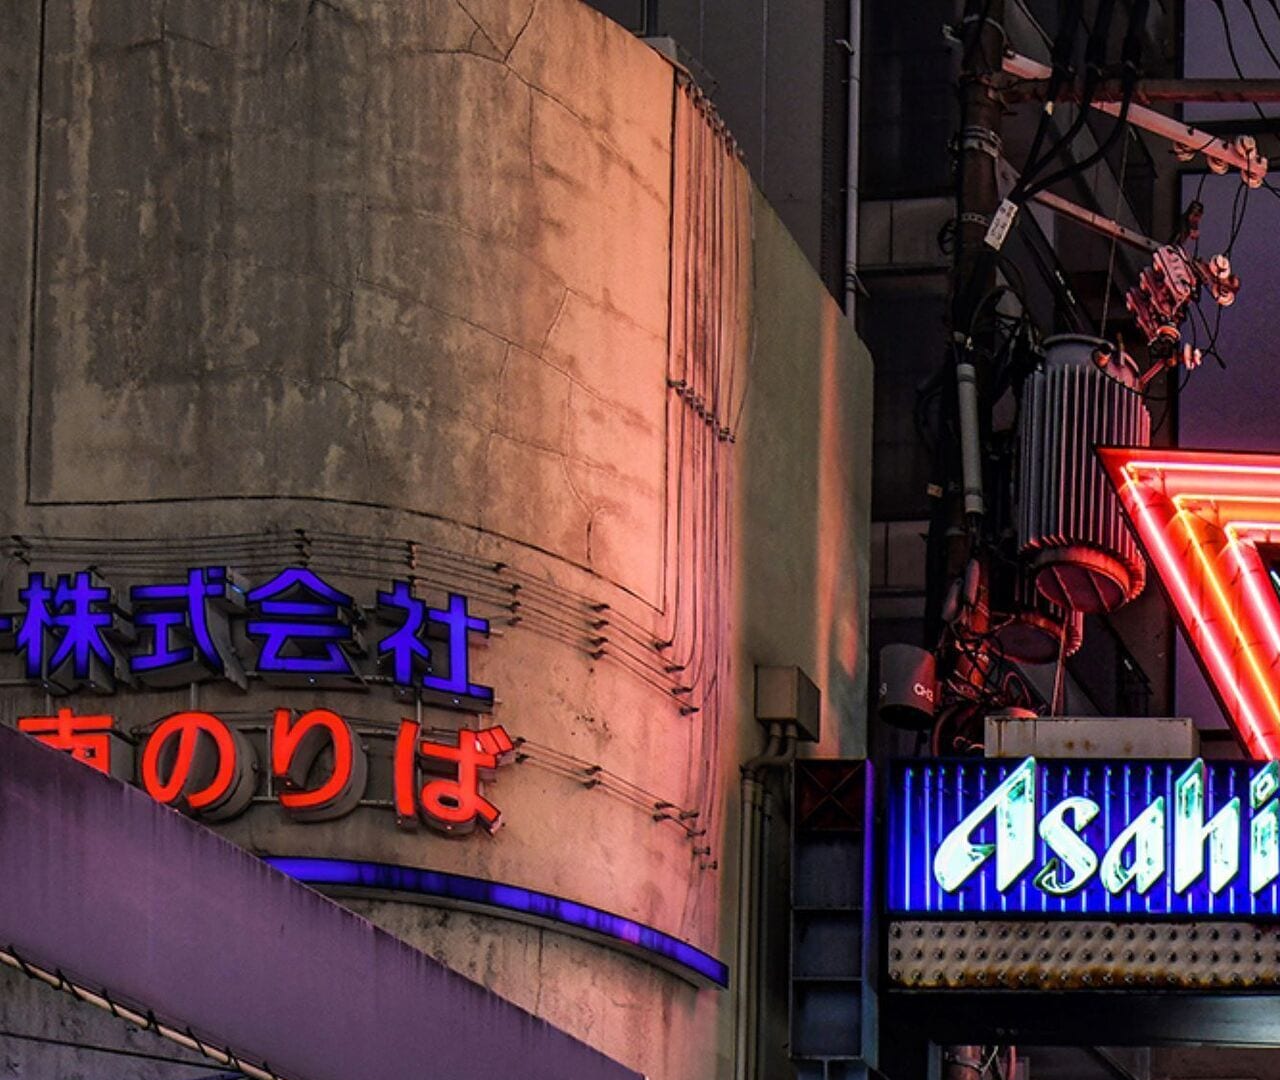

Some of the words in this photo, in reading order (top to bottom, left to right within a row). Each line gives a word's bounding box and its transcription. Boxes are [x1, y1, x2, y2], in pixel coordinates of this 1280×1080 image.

[18, 566, 494, 706] 株式会社
[934, 756, 1280, 893] Asahi
